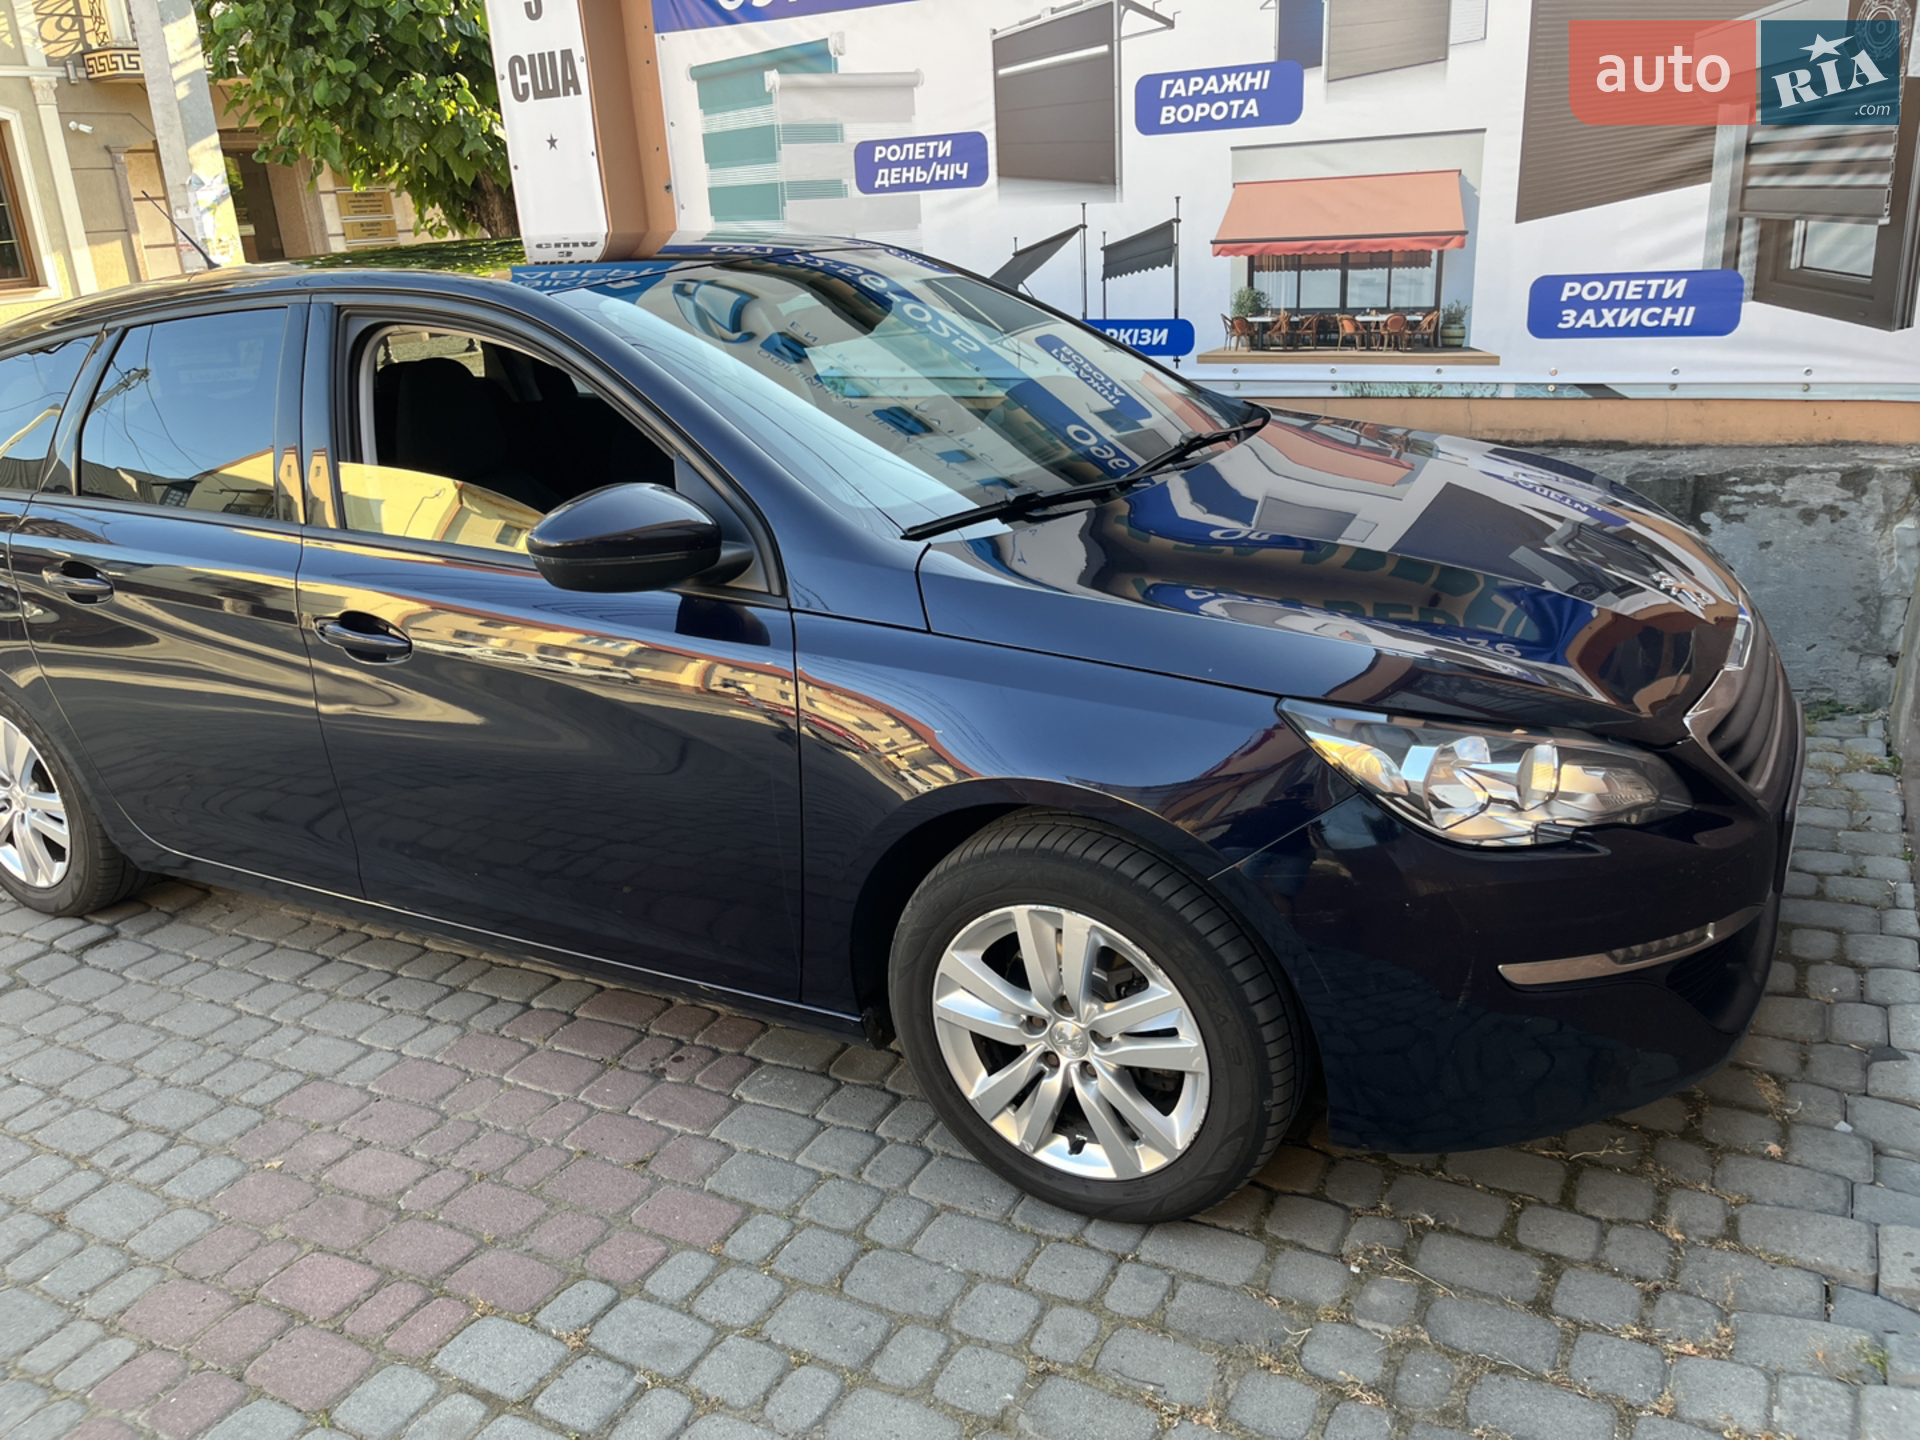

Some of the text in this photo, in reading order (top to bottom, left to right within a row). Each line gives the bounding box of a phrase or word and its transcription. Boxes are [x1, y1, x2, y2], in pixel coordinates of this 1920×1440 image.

[508, 48, 582, 103] США
[1160, 69, 1271, 99] ГАРАЖНІ
[1159, 98, 1259, 125] ВОРОТА
[874, 140, 952, 163] РОЛЕТИ
[874, 162, 969, 188] ДЕНЬ/НІЧ
[1560, 278, 1687, 302] РОЛЕТИ
[1557, 306, 1696, 329] ЗАХИСНІ
[1105, 327, 1169, 346] РКІЗИ
